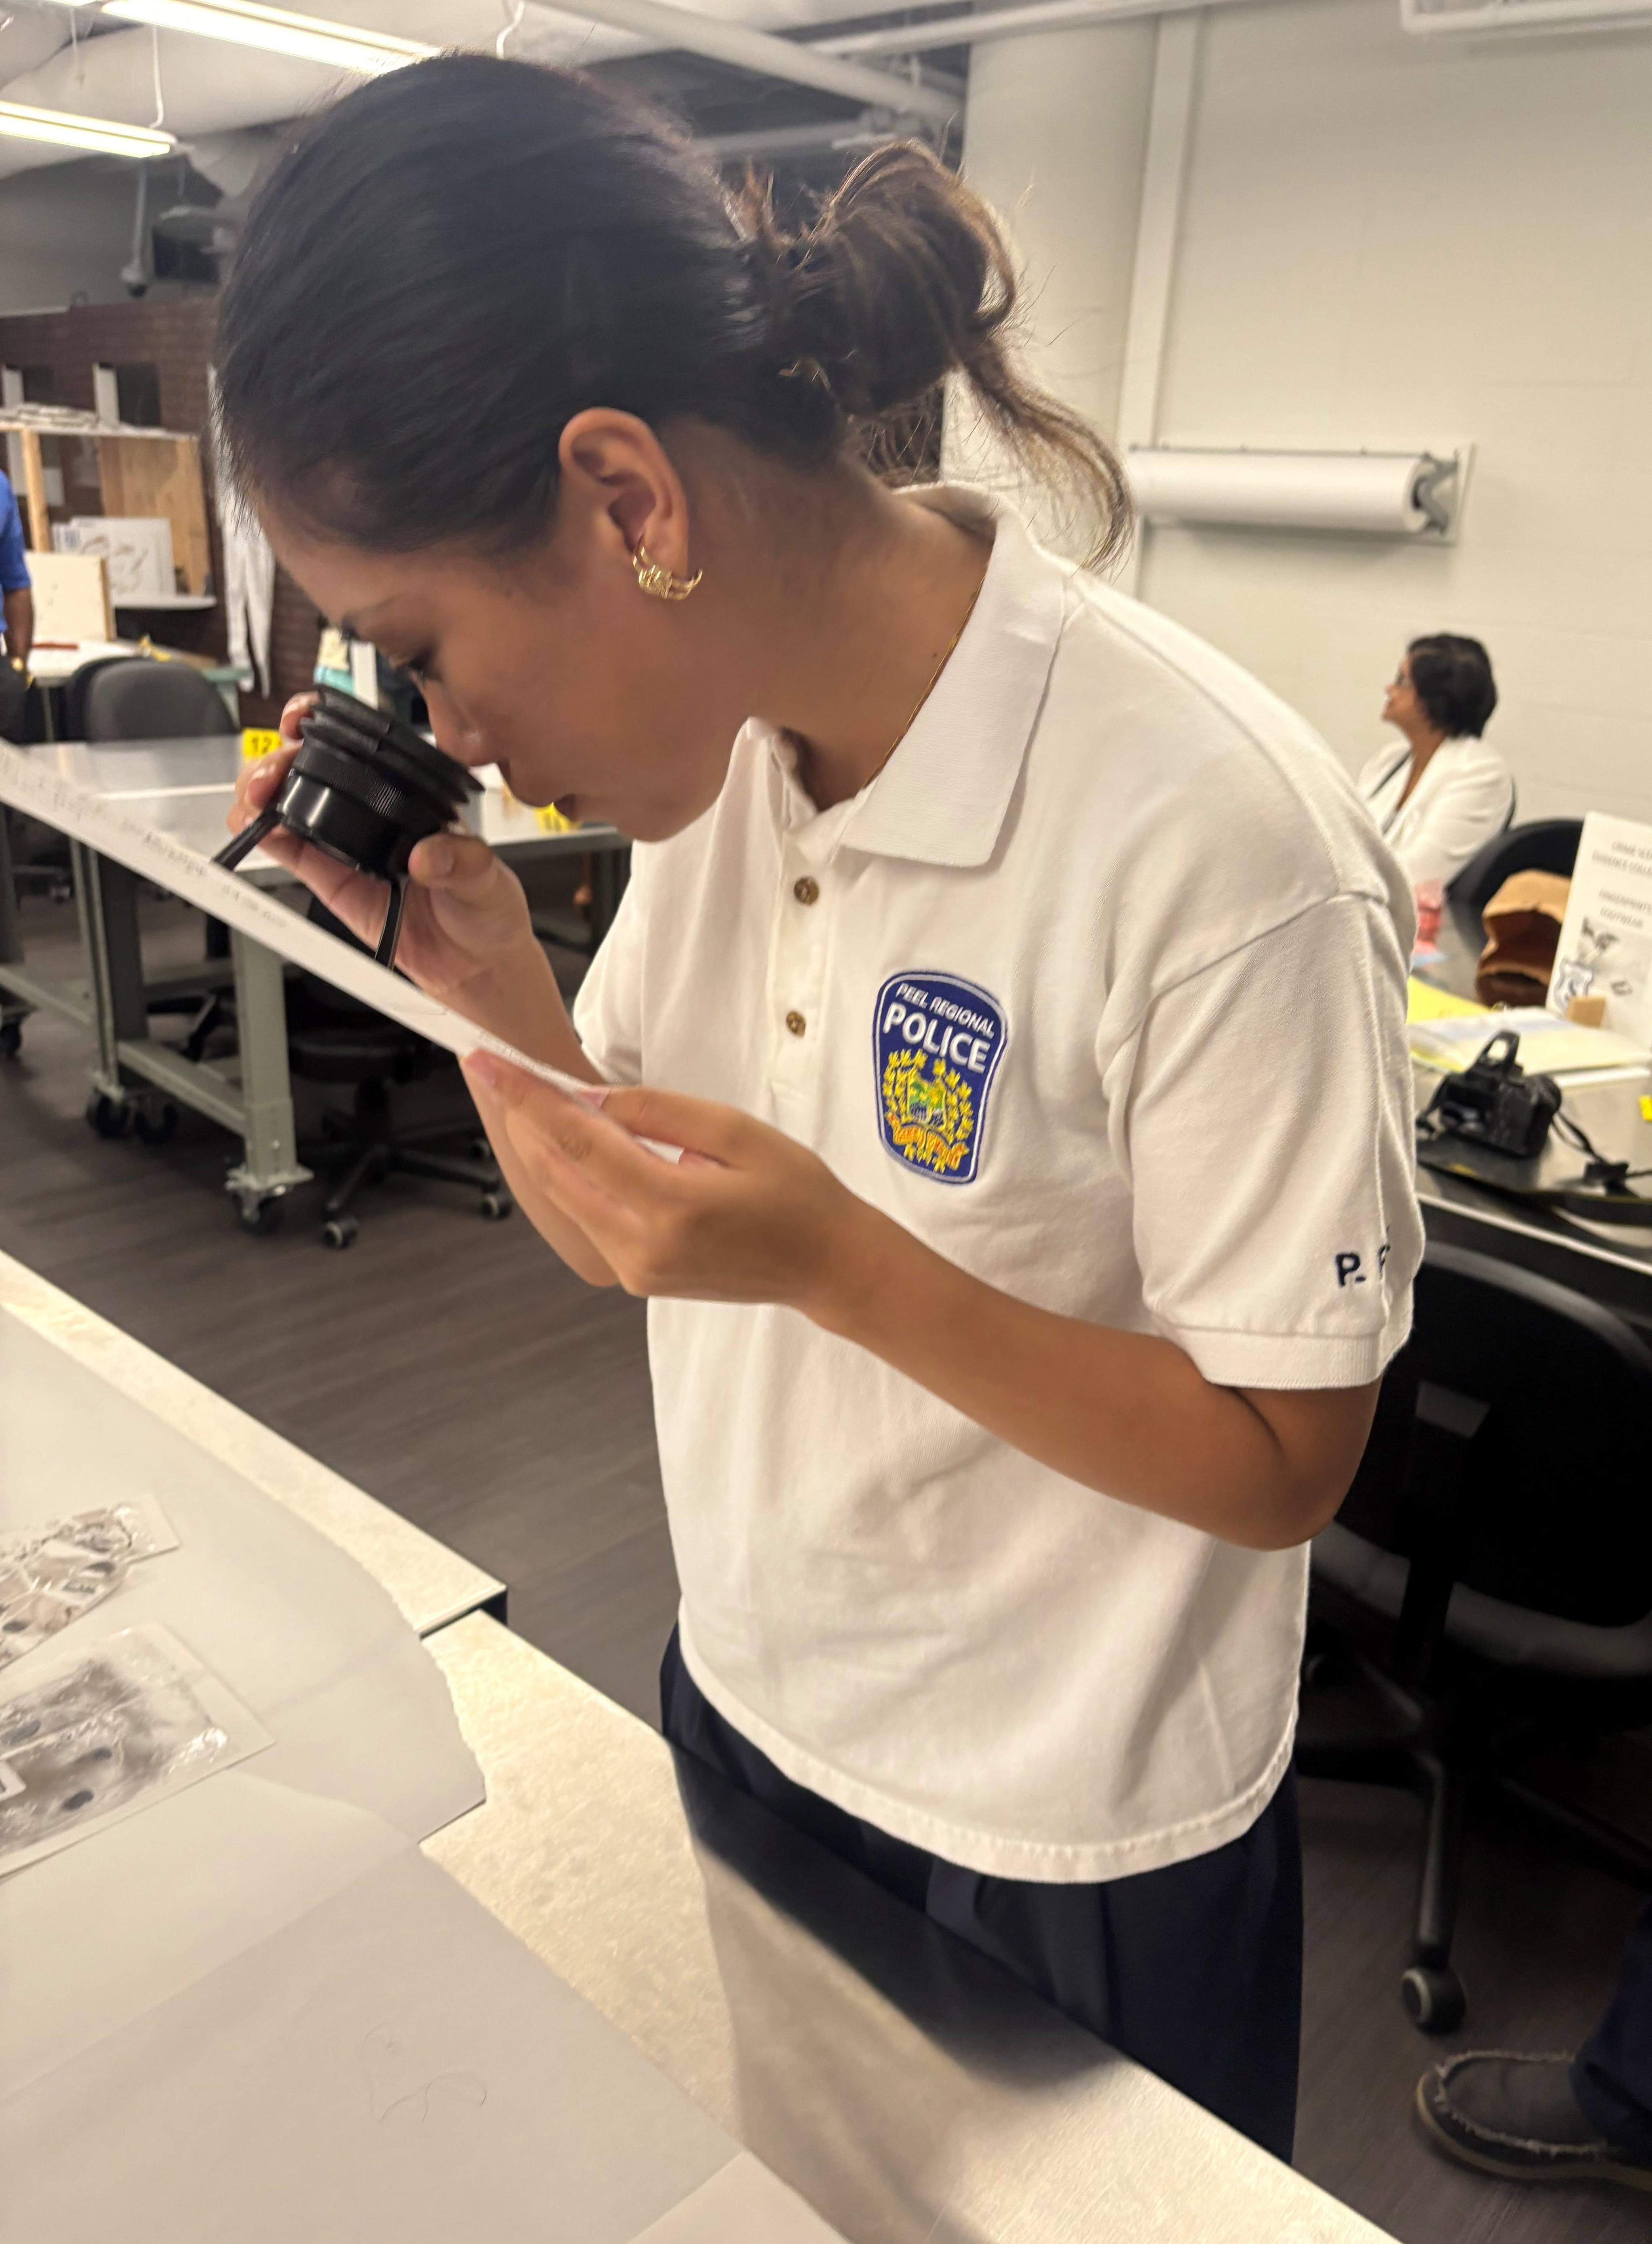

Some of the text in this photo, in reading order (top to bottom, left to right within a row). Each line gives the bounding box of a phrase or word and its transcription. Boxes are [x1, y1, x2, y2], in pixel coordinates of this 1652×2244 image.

[882, 1001, 991, 1074] POLICE
[895, 982, 995, 1040] PEEL REGIONAL
